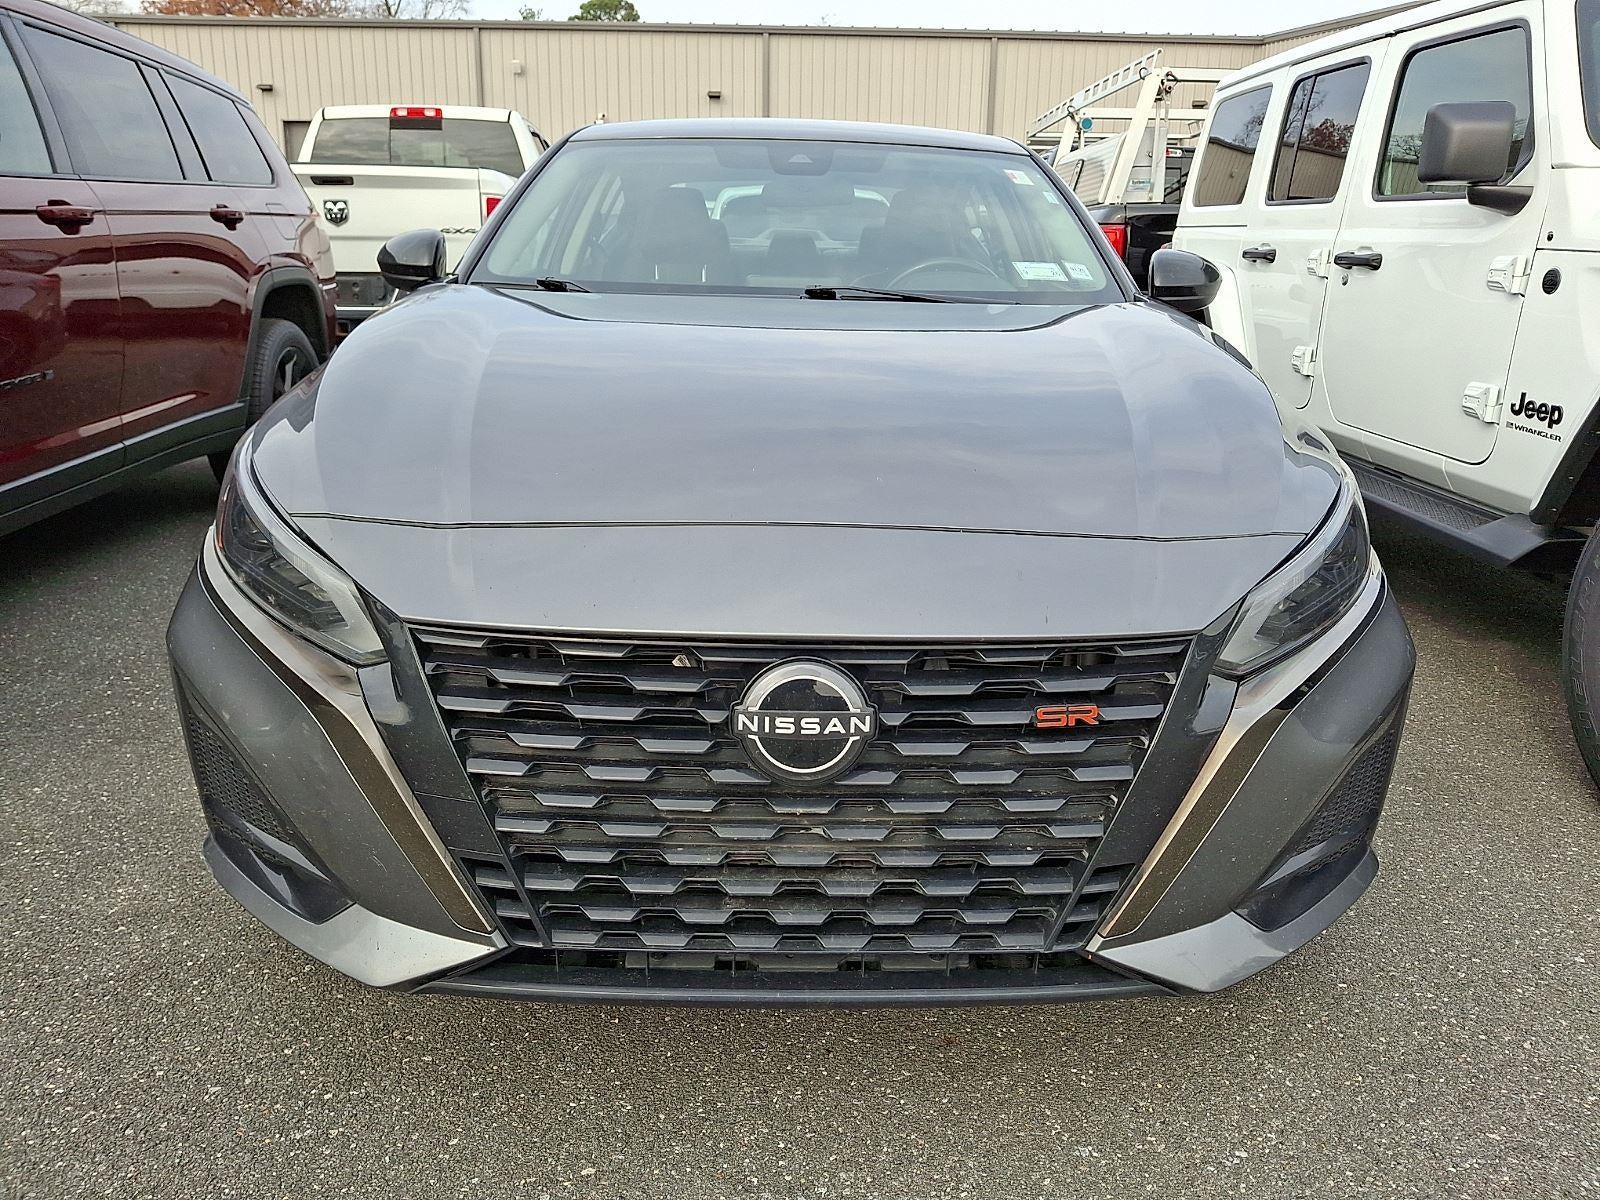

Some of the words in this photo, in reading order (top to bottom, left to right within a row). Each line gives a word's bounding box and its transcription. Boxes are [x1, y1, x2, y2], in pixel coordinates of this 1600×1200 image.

[1510, 392, 1563, 429] Jeep
[1514, 423, 1561, 442] WRANGLER
[737, 713, 870, 735] NISSAN
[1036, 705, 1099, 727] SR
